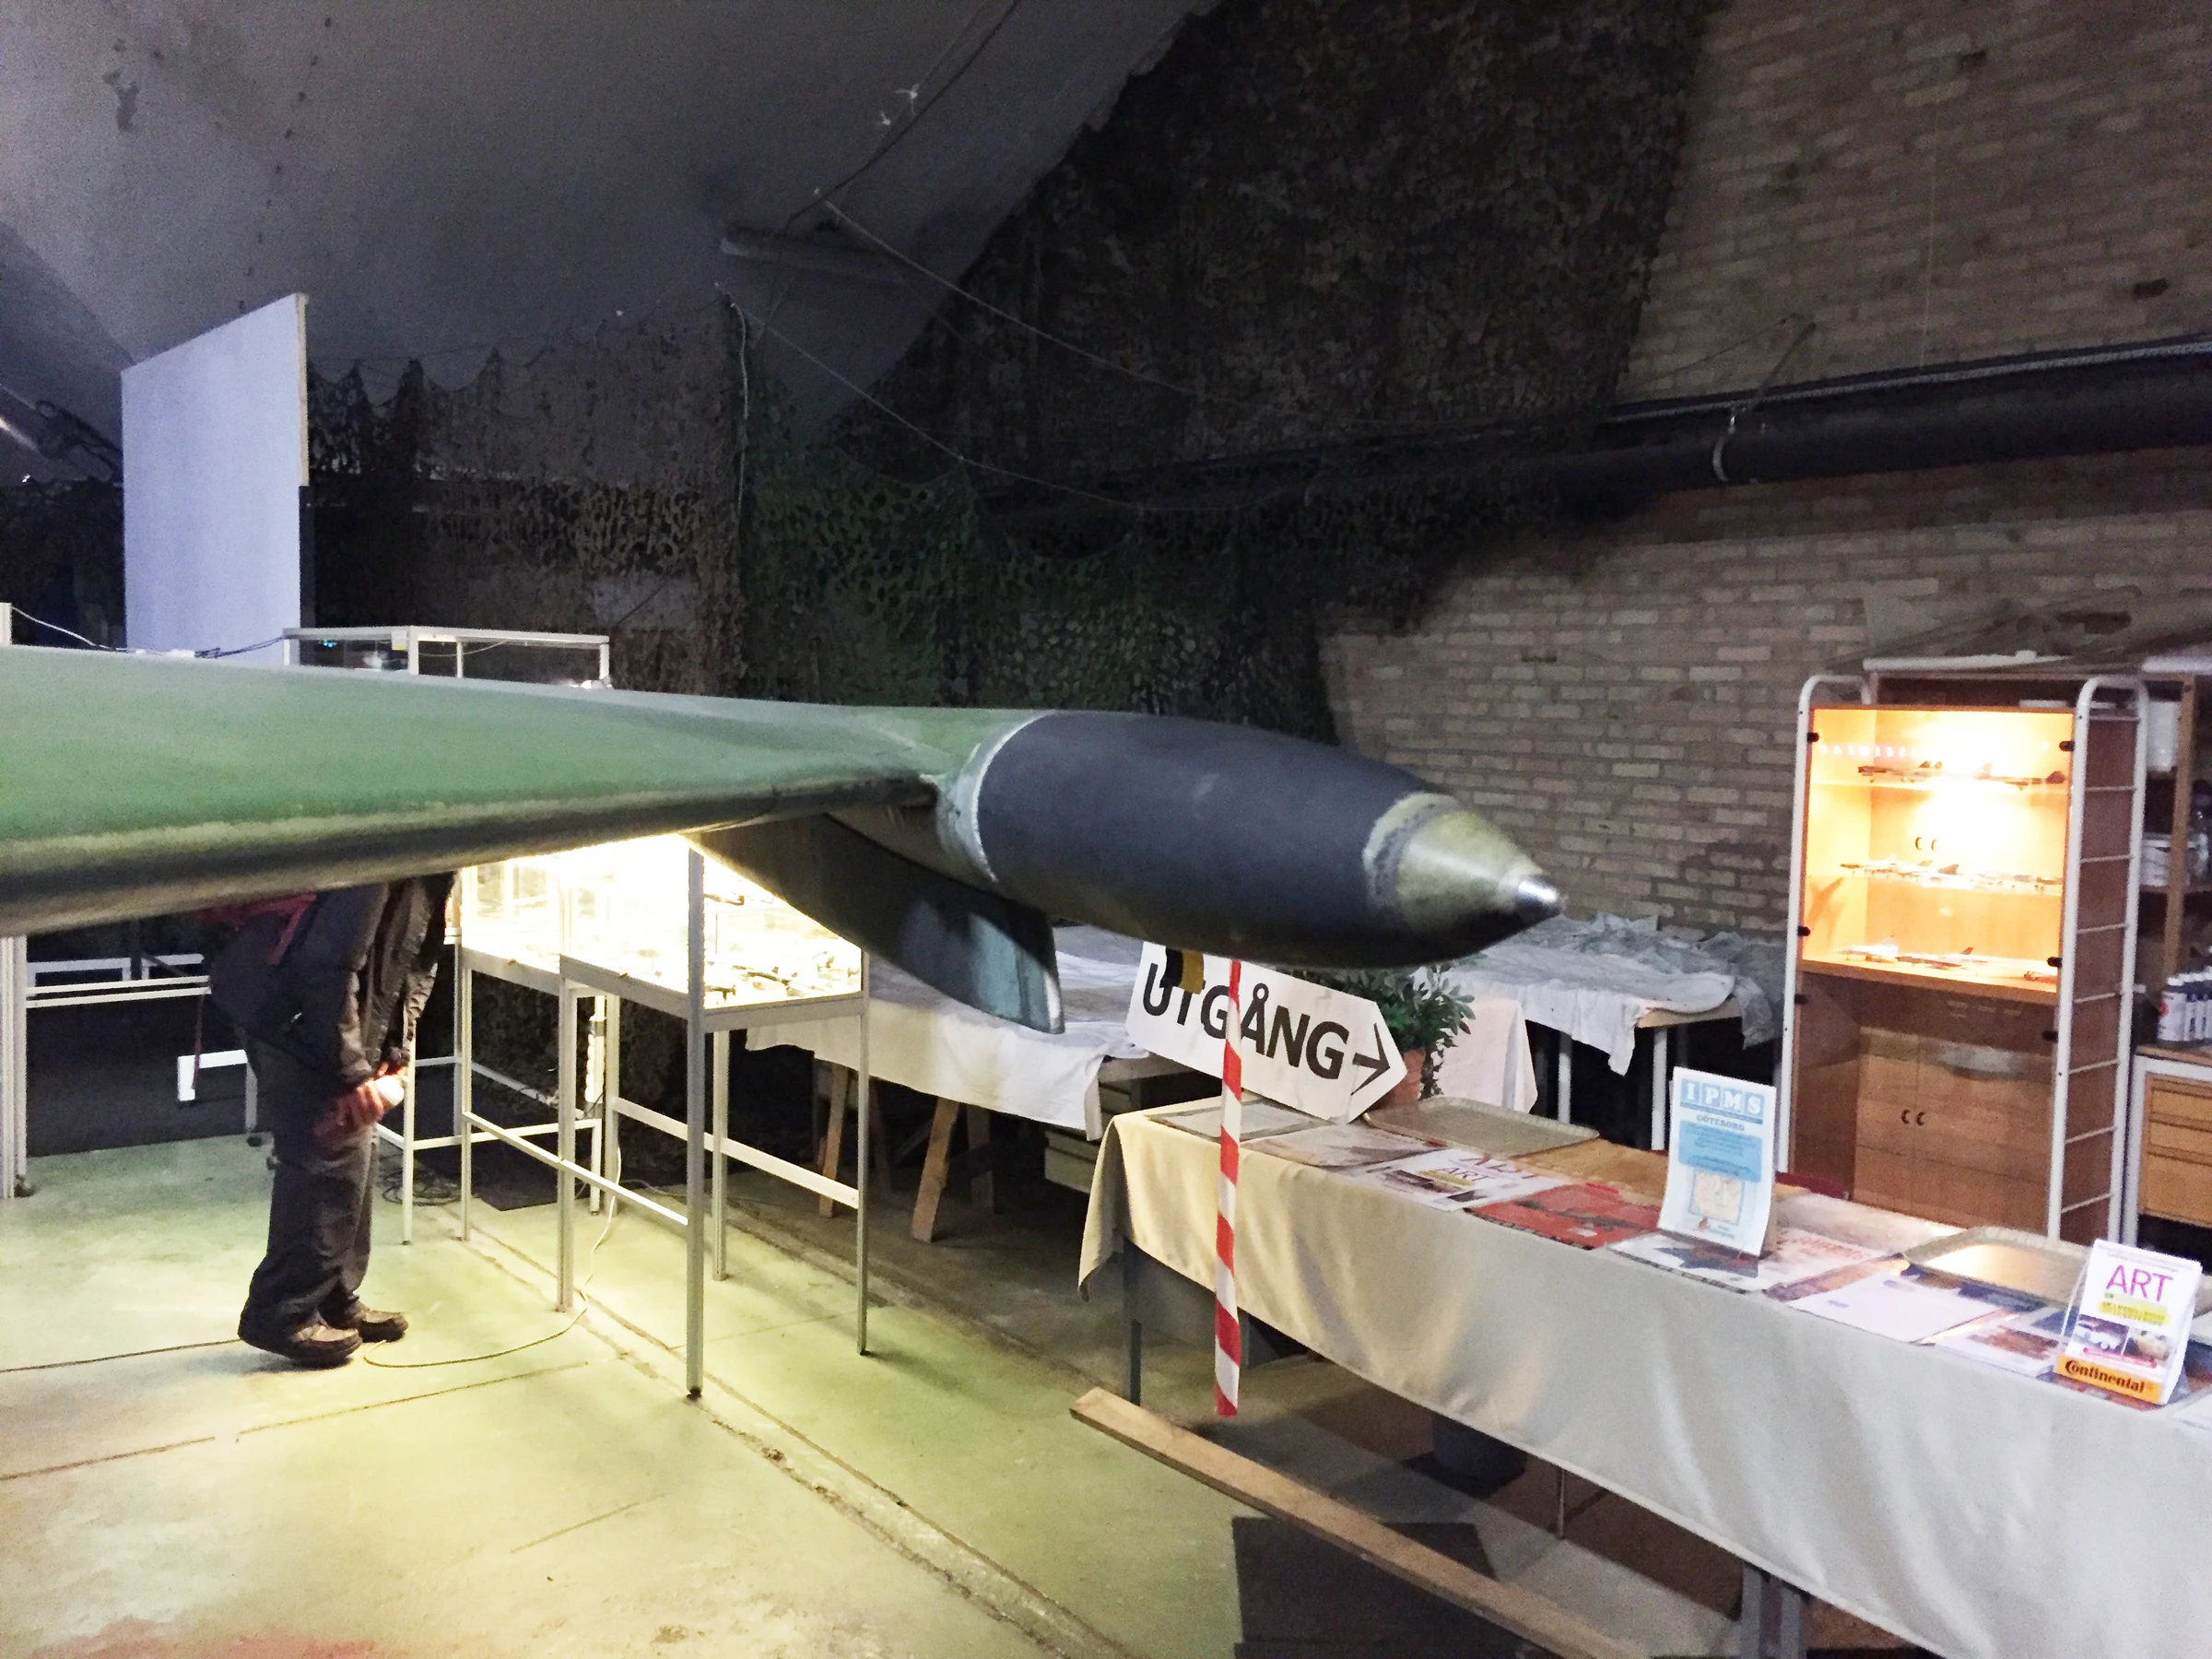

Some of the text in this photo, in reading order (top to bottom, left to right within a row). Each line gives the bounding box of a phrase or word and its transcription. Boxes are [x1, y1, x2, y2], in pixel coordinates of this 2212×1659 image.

[1685, 1081, 1762, 1115] IPMS
[1696, 1114, 1746, 1132] GÖTEBORG
[2106, 1265, 2173, 1302] ART
[2065, 1359, 2146, 1393] Continental
